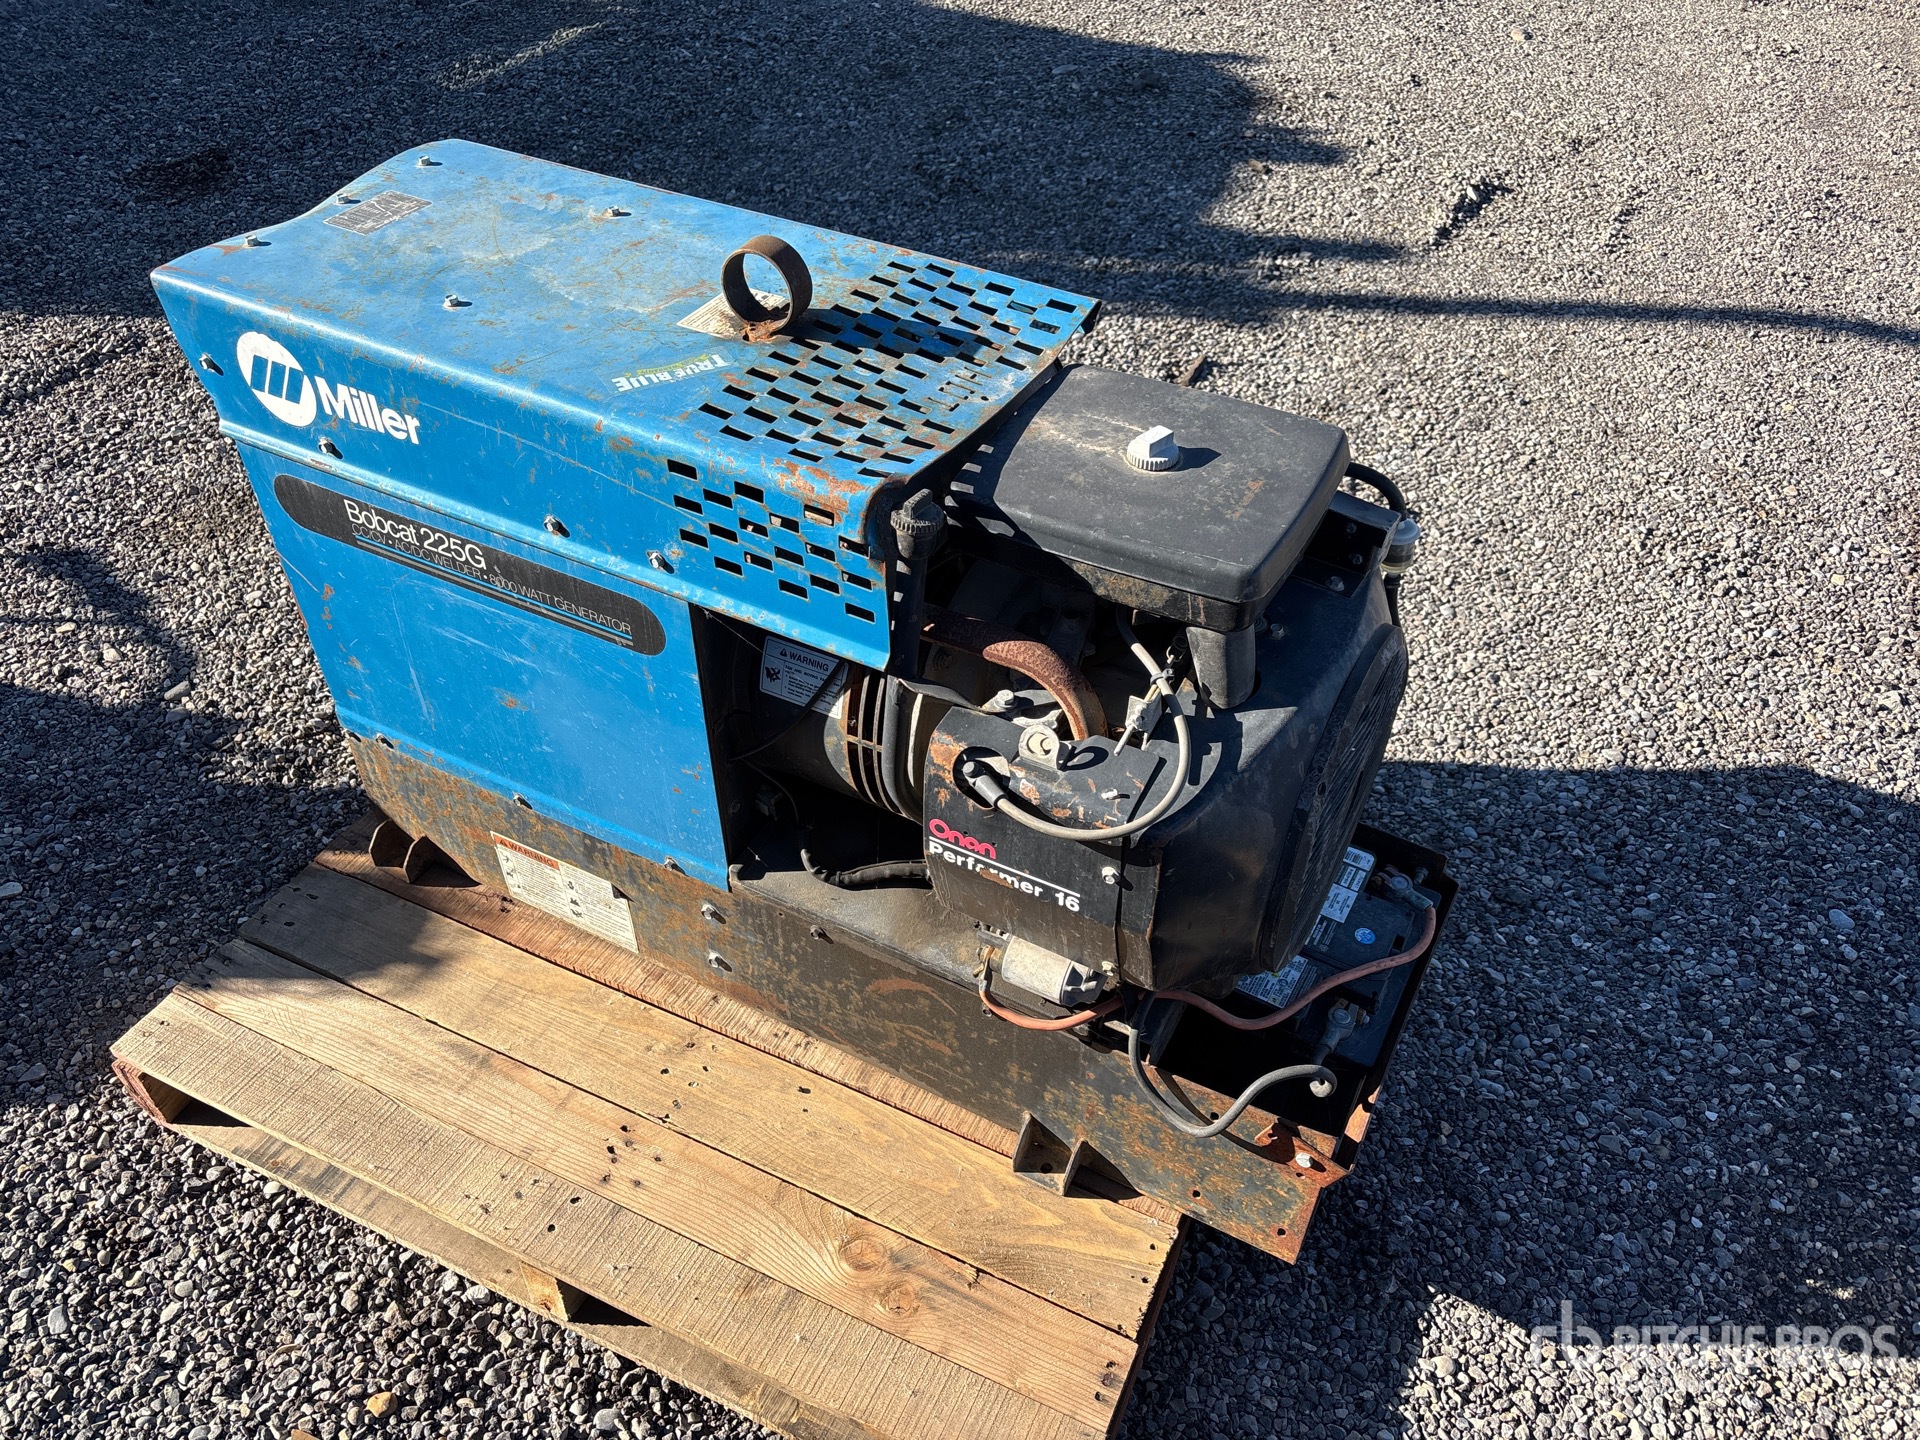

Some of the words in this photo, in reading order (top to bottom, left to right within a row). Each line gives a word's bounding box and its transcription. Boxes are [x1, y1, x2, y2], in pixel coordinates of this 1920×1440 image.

[675, 354, 731, 378] TRUE
[611, 370, 673, 392] BLUE
[314, 375, 421, 445] Miller
[343, 499, 420, 546] Bobcat
[420, 527, 487, 570] 225G
[430, 551, 482, 581] WELDER
[489, 573, 518, 593] 8000
[517, 583, 552, 604] WATT
[553, 596, 632, 635] GENERATOR
[789, 651, 829, 672] WARNING
[928, 818, 997, 860] Onan
[509, 841, 554, 868] WARNING
[1054, 892, 1081, 912] 16
